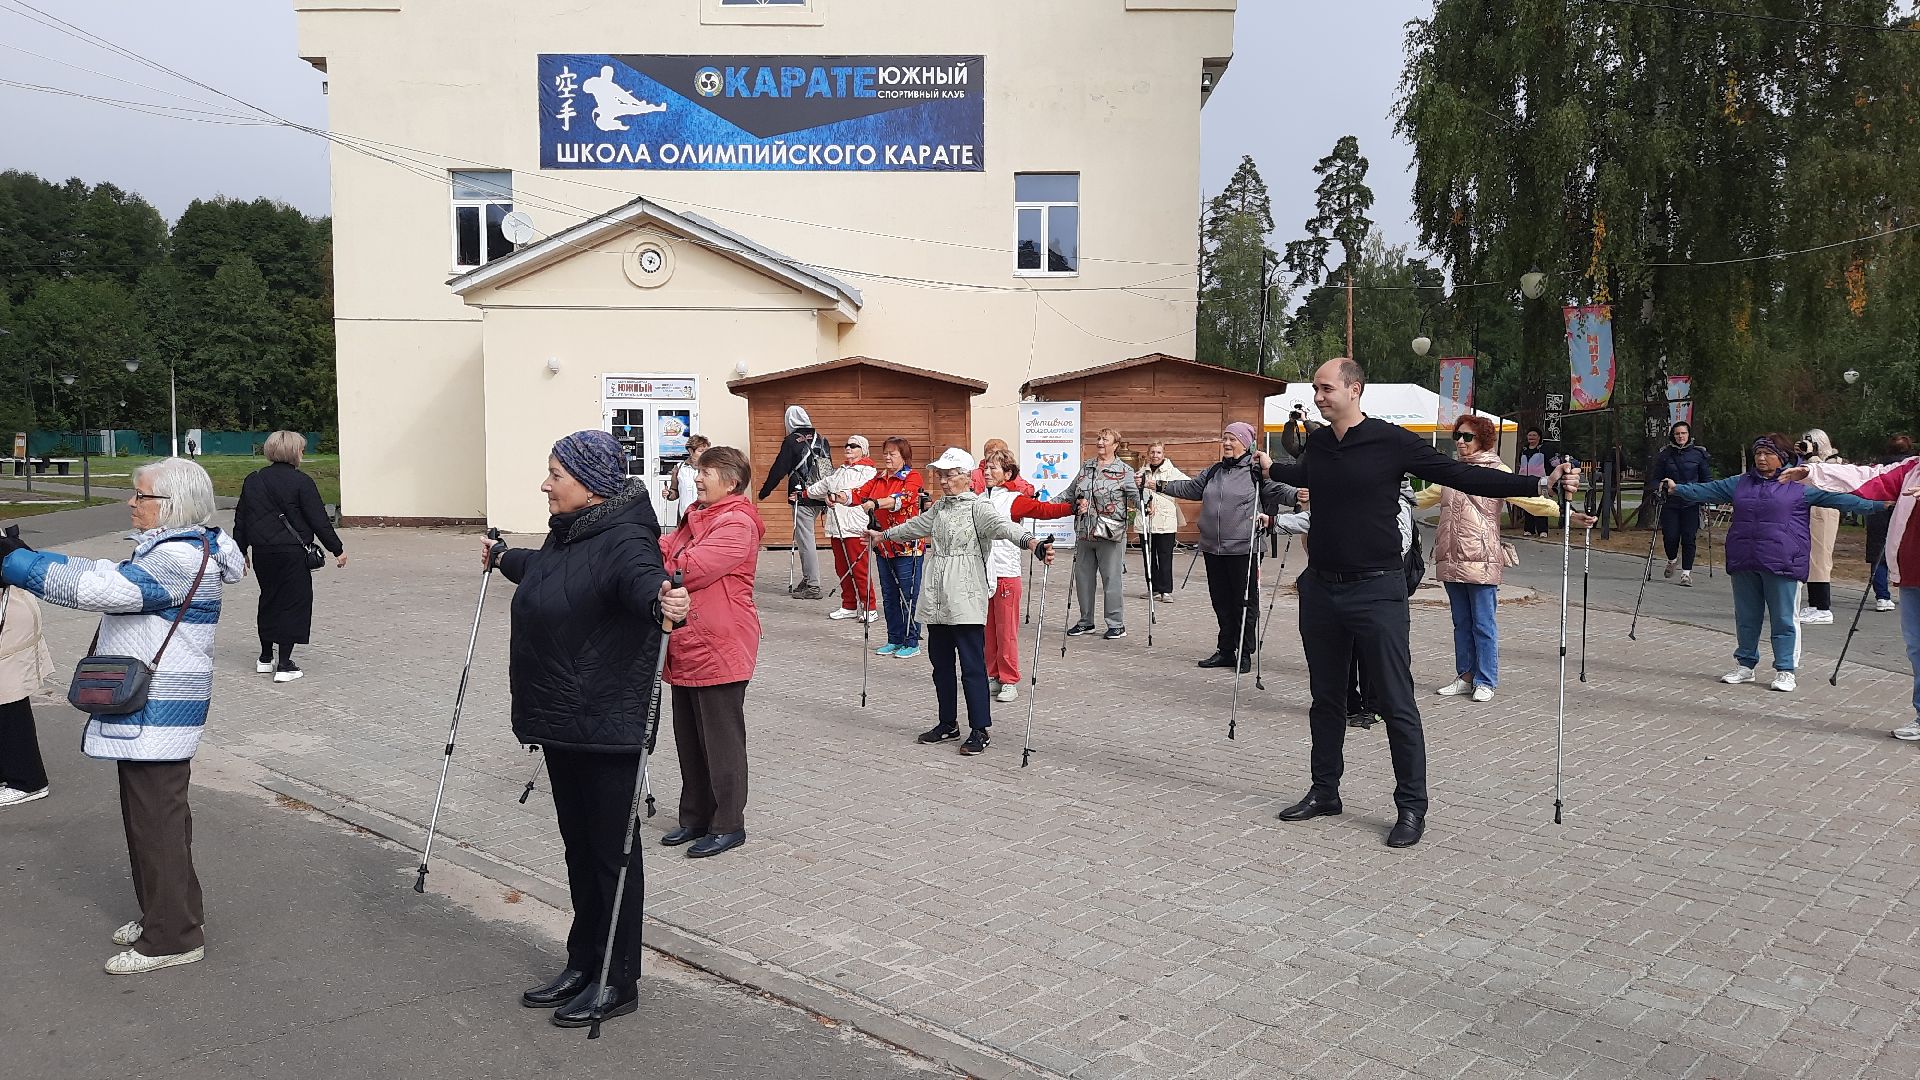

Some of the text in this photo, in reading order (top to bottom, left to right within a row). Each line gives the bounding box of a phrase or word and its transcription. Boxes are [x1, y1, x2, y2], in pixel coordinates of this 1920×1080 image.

[878, 62, 968, 85] ЮЖНЫЙ
[877, 88, 965, 99] СПОРТИВНЫЙ КЛУБ
[557, 141, 974, 165] ШКОЛА ОЛИМПИЙСКОГО КАРАТЕ
[1587, 335, 1600, 376] МИРА
[617, 383, 653, 393] ЮЖНЫЙ
[1025, 417, 1073, 428] Активное
